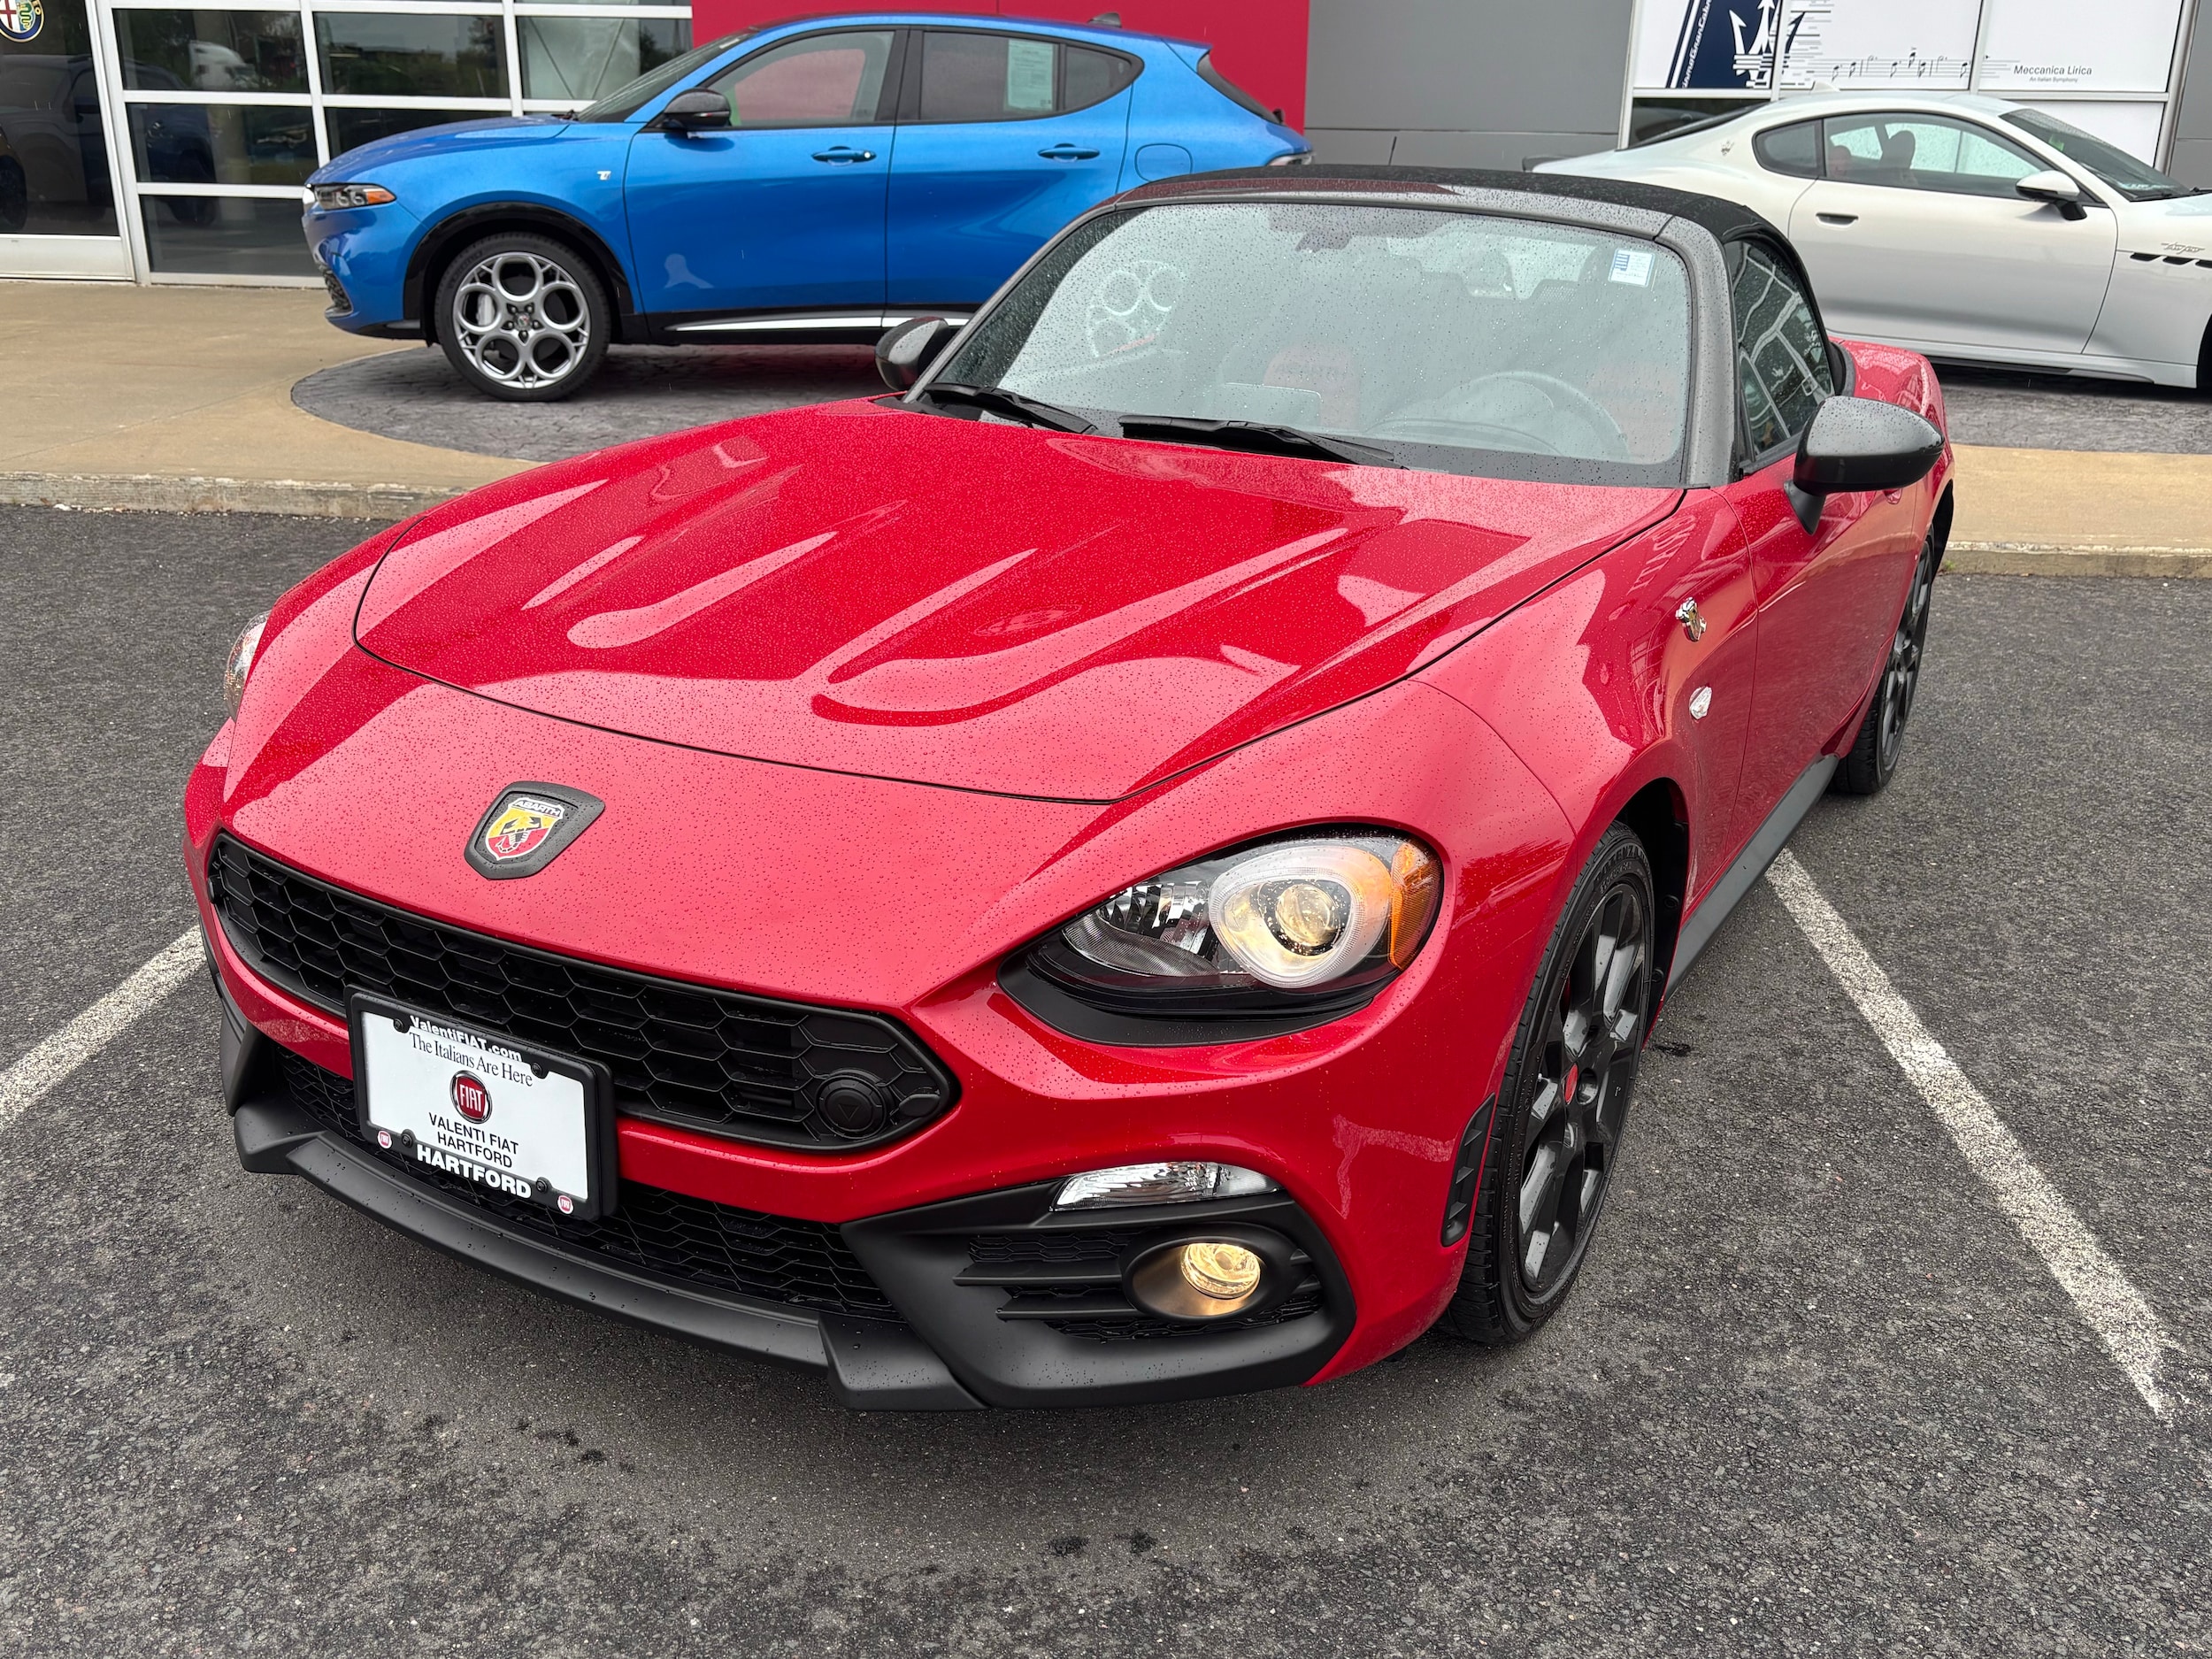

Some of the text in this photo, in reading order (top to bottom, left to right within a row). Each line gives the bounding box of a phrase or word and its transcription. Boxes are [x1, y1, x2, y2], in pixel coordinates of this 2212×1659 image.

[2013, 65, 2093, 75] Meccanica Lirica
[514, 800, 560, 817] ABARTH
[409, 1032, 534, 1087] The Italians Are Here
[410, 1015, 523, 1063] ValentiFIAT.com
[459, 1084, 483, 1112] FIAT
[428, 1111, 519, 1155] VALENTI FIAT
[437, 1131, 513, 1169] HARTFORD
[417, 1143, 532, 1199] HARTFORD
